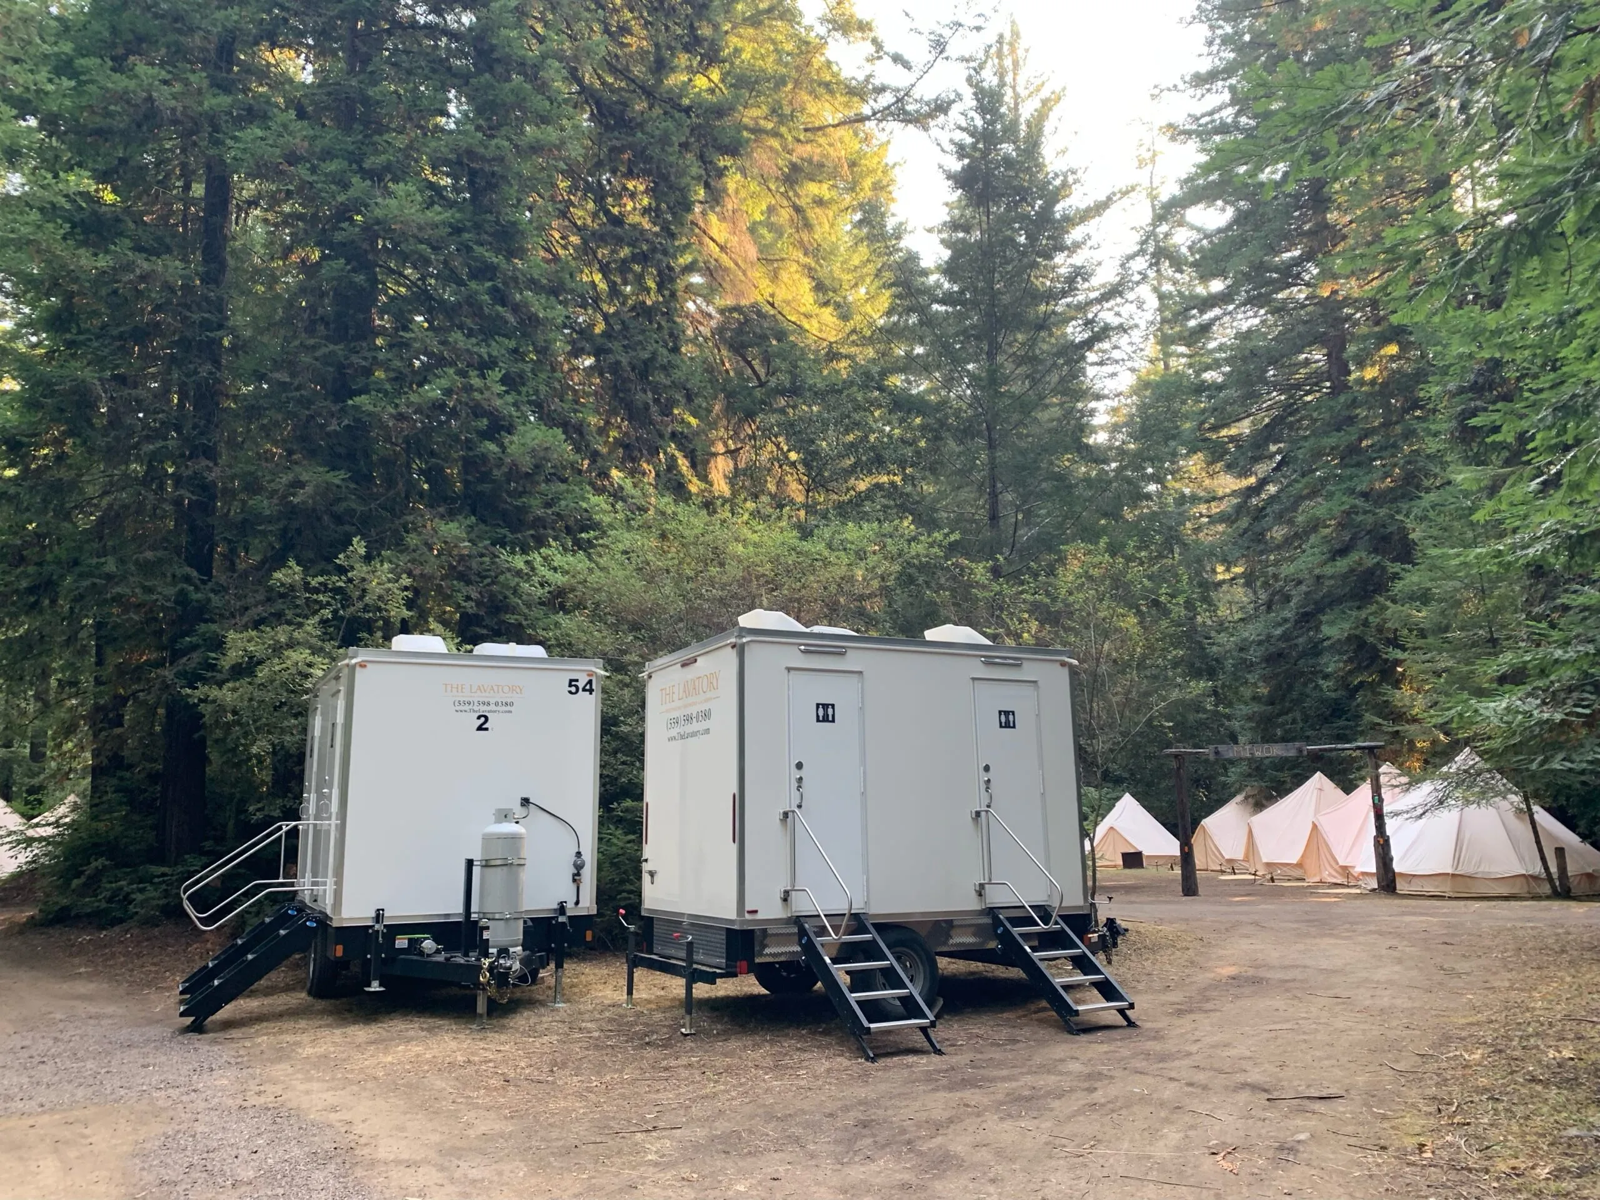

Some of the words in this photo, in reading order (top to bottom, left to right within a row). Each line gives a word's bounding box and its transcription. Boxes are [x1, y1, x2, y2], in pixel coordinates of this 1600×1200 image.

[442, 683, 466, 694] THE
[469, 683, 525, 695] LAVATORY
[567, 678, 595, 695] 54
[659, 685, 675, 706] THE
[677, 670, 721, 701] LAVATORY
[475, 714, 489, 732] 2
[1233, 745, 1284, 757] MIWOK
